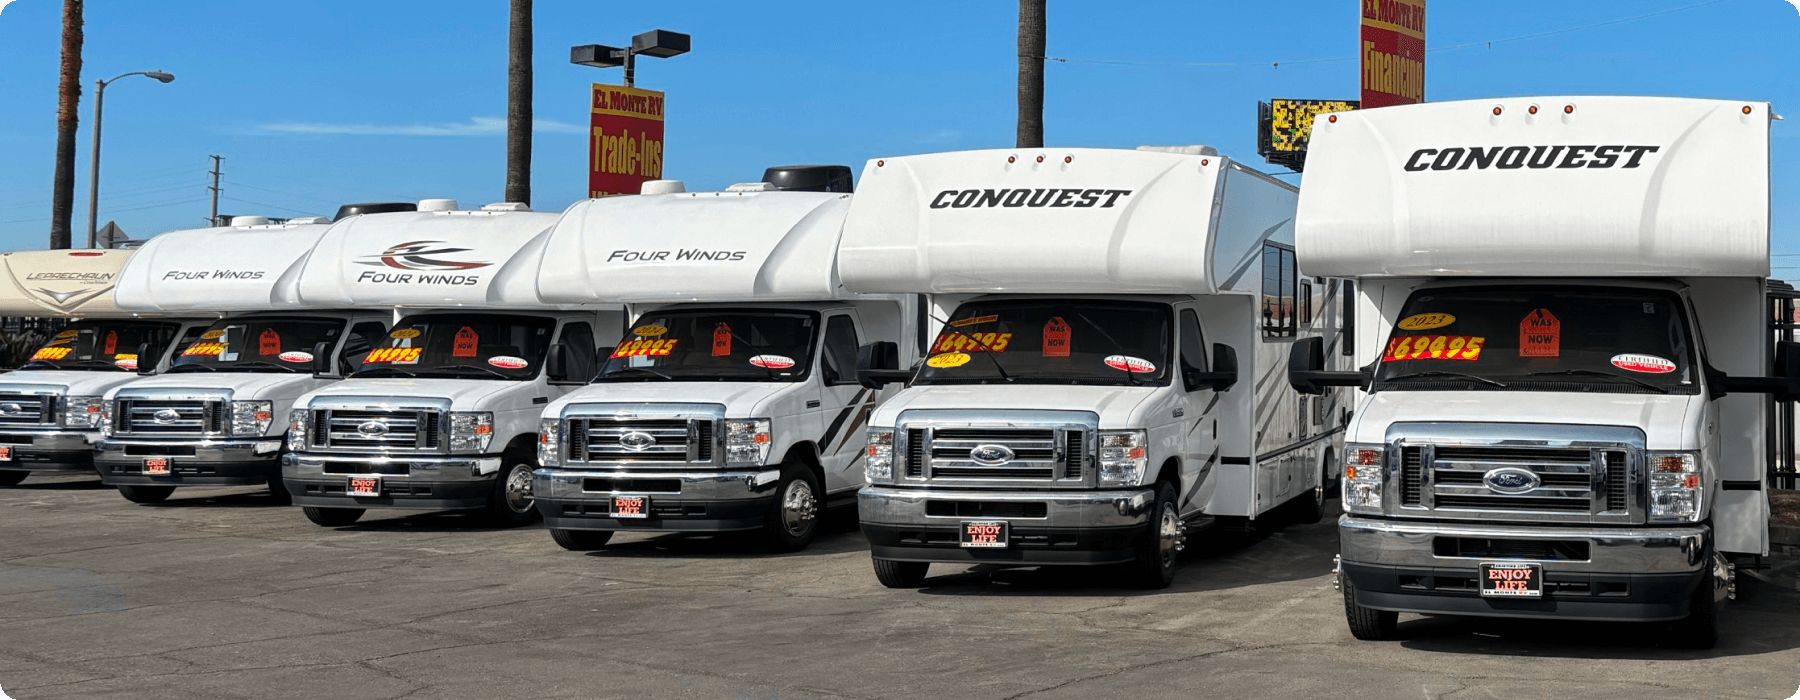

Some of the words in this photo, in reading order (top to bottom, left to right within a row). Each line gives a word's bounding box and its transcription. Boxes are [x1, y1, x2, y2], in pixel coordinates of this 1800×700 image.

[1364, 40, 1423, 103] Financing
[593, 89, 608, 110] EL
[609, 91, 647, 114] MONTE
[648, 96, 663, 116] RV
[593, 126, 662, 178] Trade-Ins
[1403, 144, 1660, 172] CONQUEST
[929, 188, 1133, 209] CONQUEST
[606, 249, 670, 262] FOUR
[675, 248, 747, 261] WINDS
[26, 272, 116, 280] LEPRECHAUN
[162, 270, 210, 281] FOUR
[212, 269, 265, 280] WINDS
[357, 271, 413, 284] FOUR
[418, 274, 479, 286] WINDS
[1406, 315, 1447, 328] 2023
[1530, 318, 1552, 327] WAS
[1047, 339, 1067, 347] NOW
[1528, 334, 1554, 344] NOW
[615, 499, 643, 507] ENJOY
[619, 507, 640, 515] LIFE
[967, 526, 1001, 535] ENJOY
[972, 535, 997, 543] LIFE
[1489, 569, 1532, 581] ENJOY
[1495, 581, 1527, 591] LIFE
